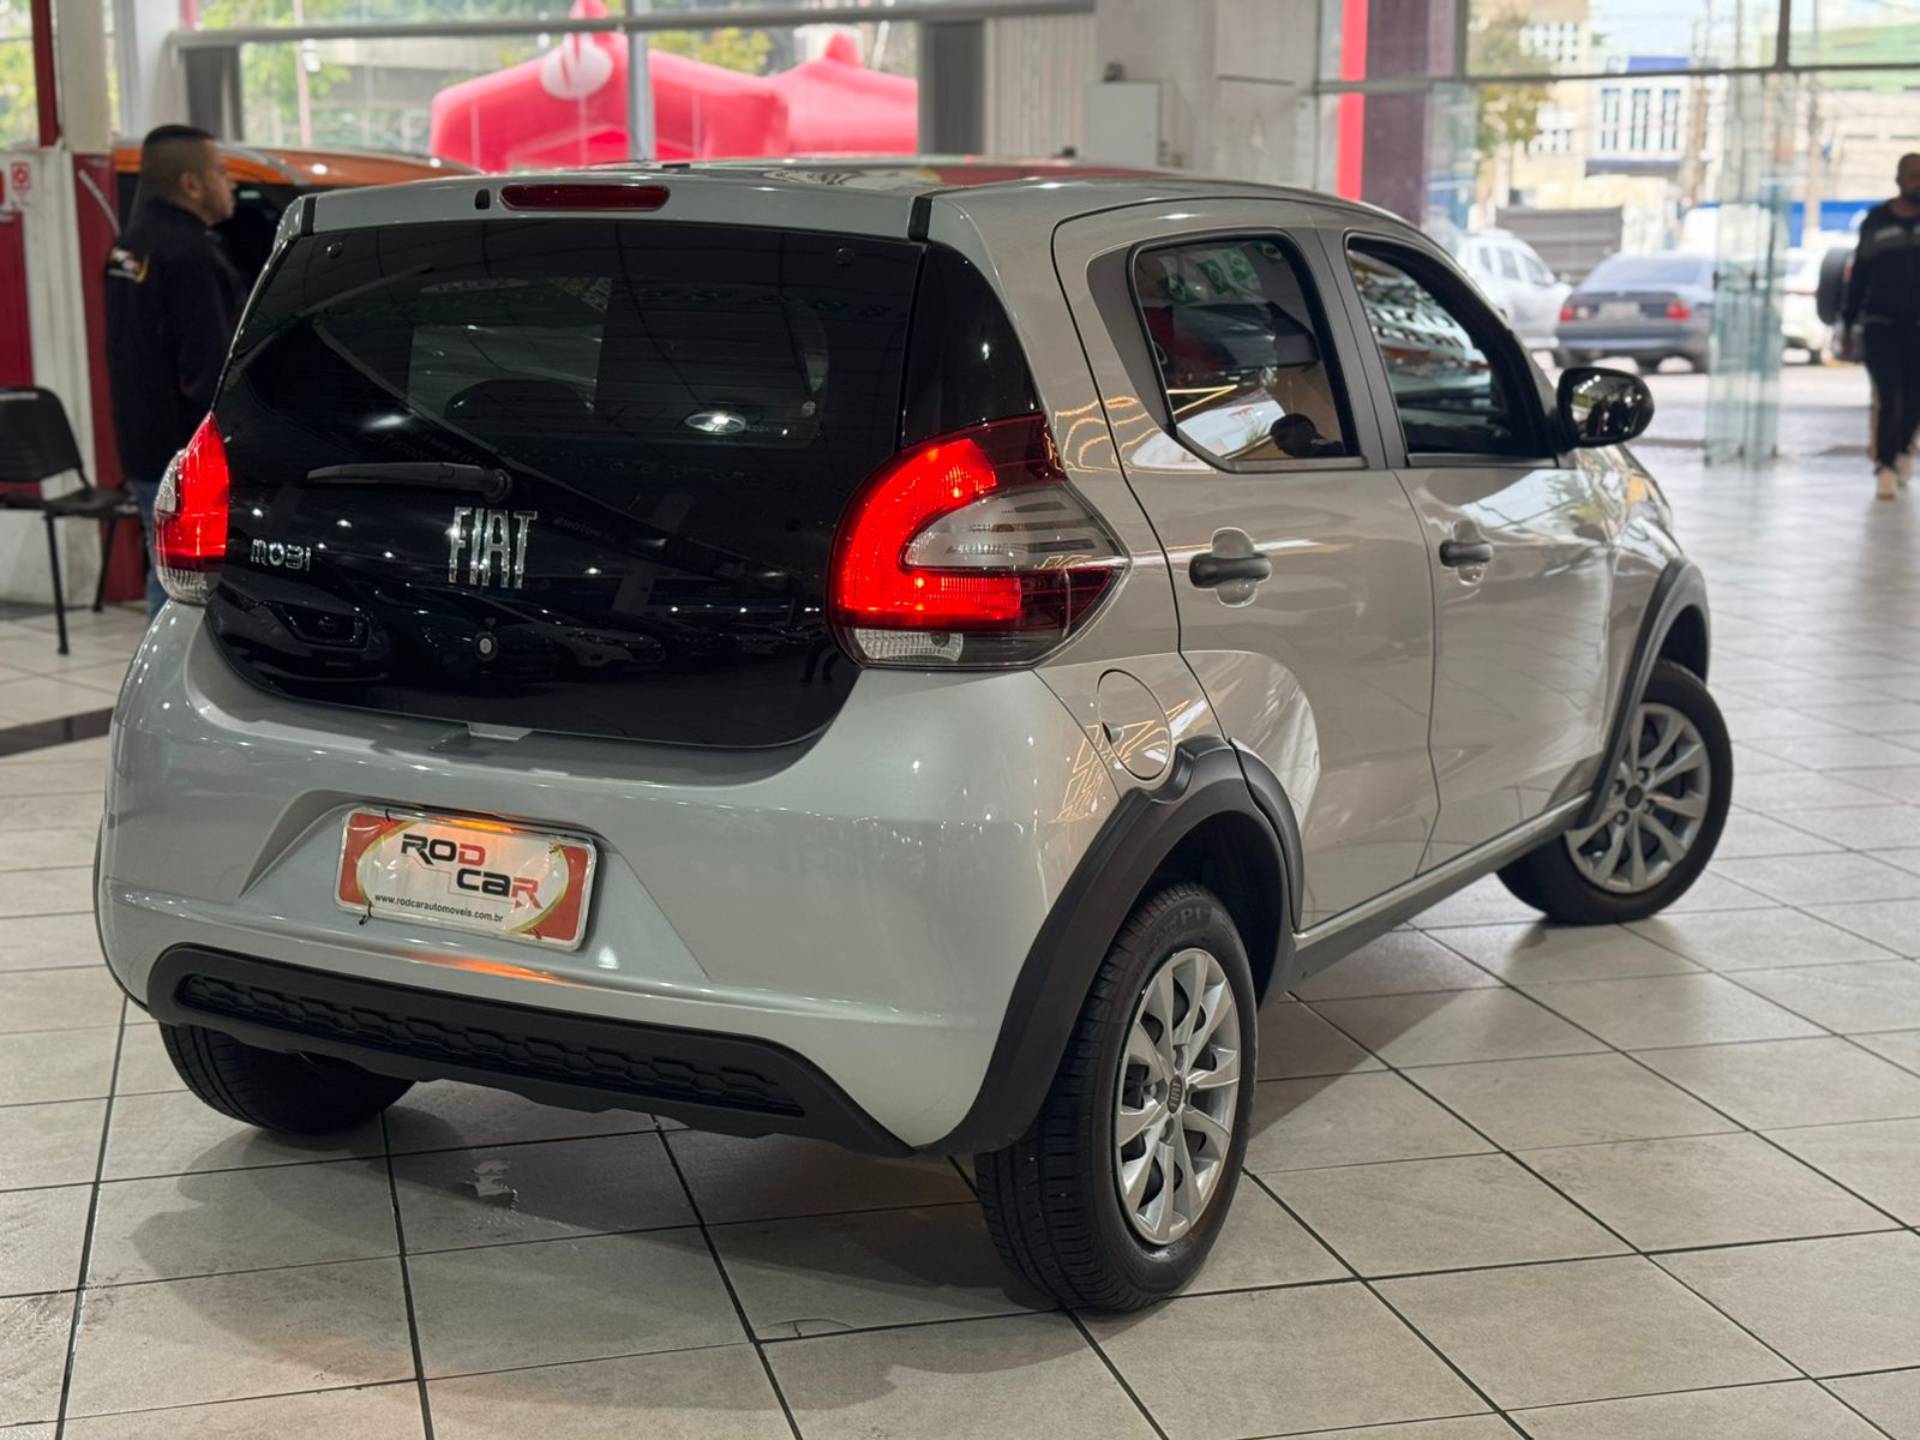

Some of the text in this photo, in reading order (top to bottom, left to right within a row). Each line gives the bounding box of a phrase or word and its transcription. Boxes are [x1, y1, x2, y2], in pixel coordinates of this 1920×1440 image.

[449, 506, 538, 589] FIAT
[401, 833, 487, 867] ROD
[374, 894, 504, 923] www.rodcarautomoveis.com.br
